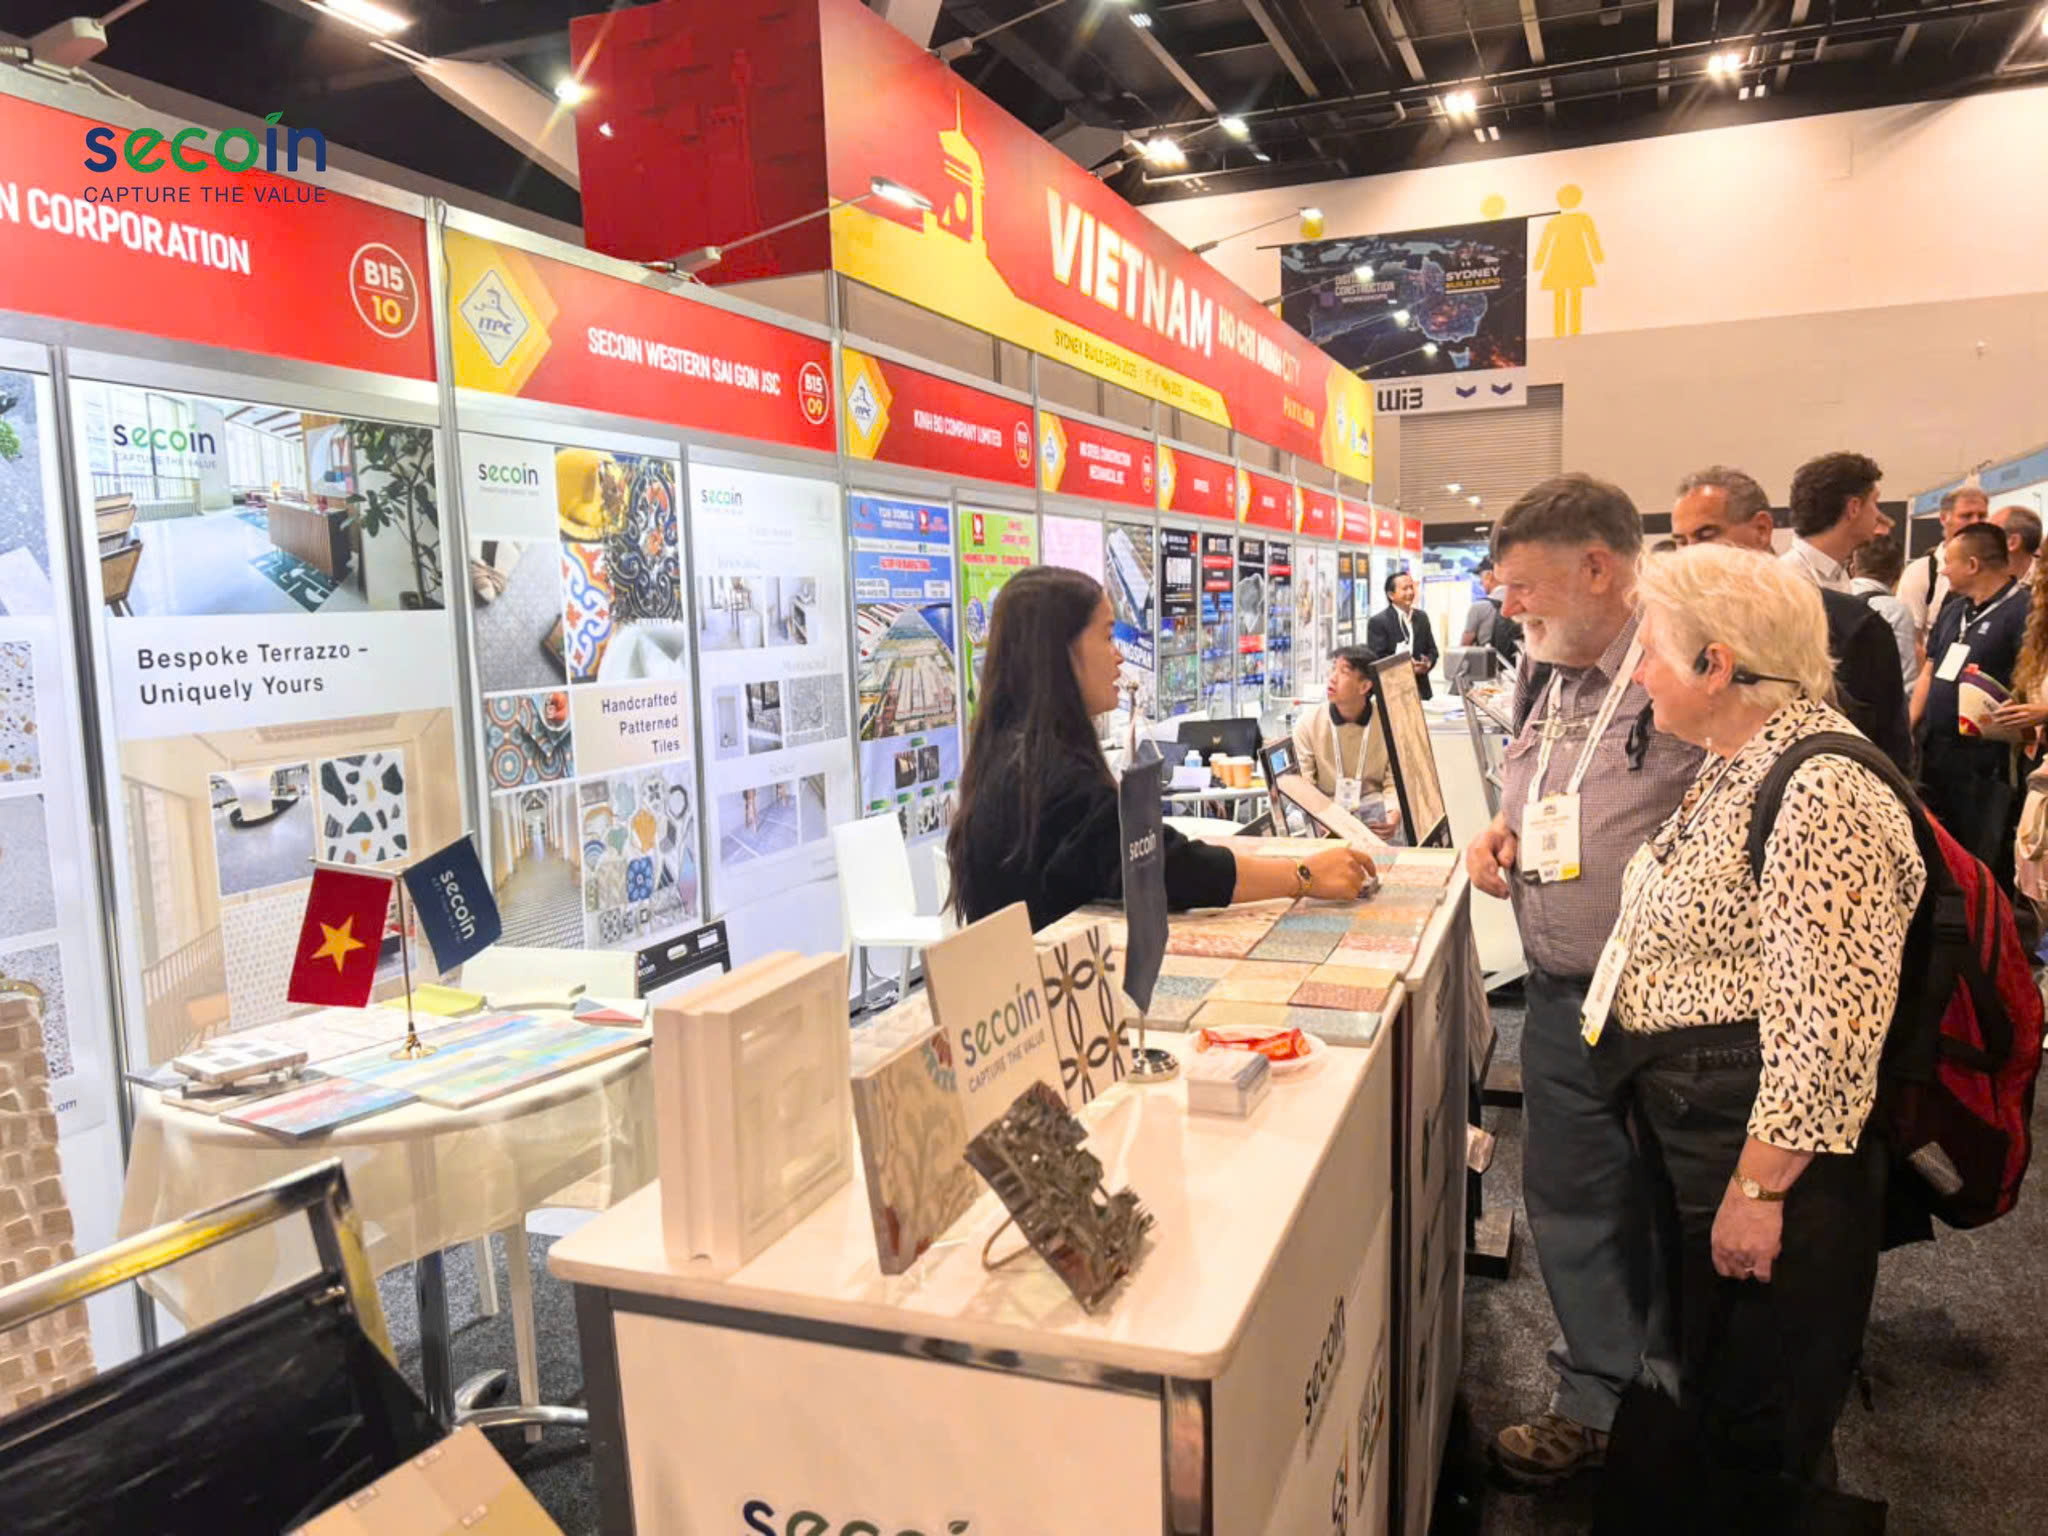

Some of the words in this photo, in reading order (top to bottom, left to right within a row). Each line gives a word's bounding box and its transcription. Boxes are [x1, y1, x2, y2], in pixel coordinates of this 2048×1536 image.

[27, 187, 251, 275] CORPORATION
[363, 258, 404, 292] B15
[1046, 186, 1214, 358] VIETNAM
[1218, 304, 1235, 350] HO
[1445, 266, 1500, 282] SYDNEY
[1335, 281, 1395, 296] CONSTRUCTION
[372, 294, 402, 324] 10
[587, 327, 643, 365] SECOIN
[644, 341, 710, 380] WESTERN
[711, 358, 734, 384] SAI
[761, 371, 781, 396] JSC
[804, 373, 823, 393] B15
[806, 397, 823, 415] 09
[112, 423, 216, 454] secoin
[478, 462, 539, 486] secoin
[701, 487, 743, 506] secoin
[137, 645, 249, 671] Bespoke
[257, 643, 351, 663] Terrazzo
[140, 679, 253, 706] Uniquely
[262, 676, 324, 696] Yours
[601, 691, 678, 714] Handcrafted
[619, 715, 679, 736] Patterned
[651, 738, 681, 755] Tiles
[1129, 829, 1157, 862] secoin
[440, 869, 477, 940] secoin
[961, 982, 1041, 1068] secoin
